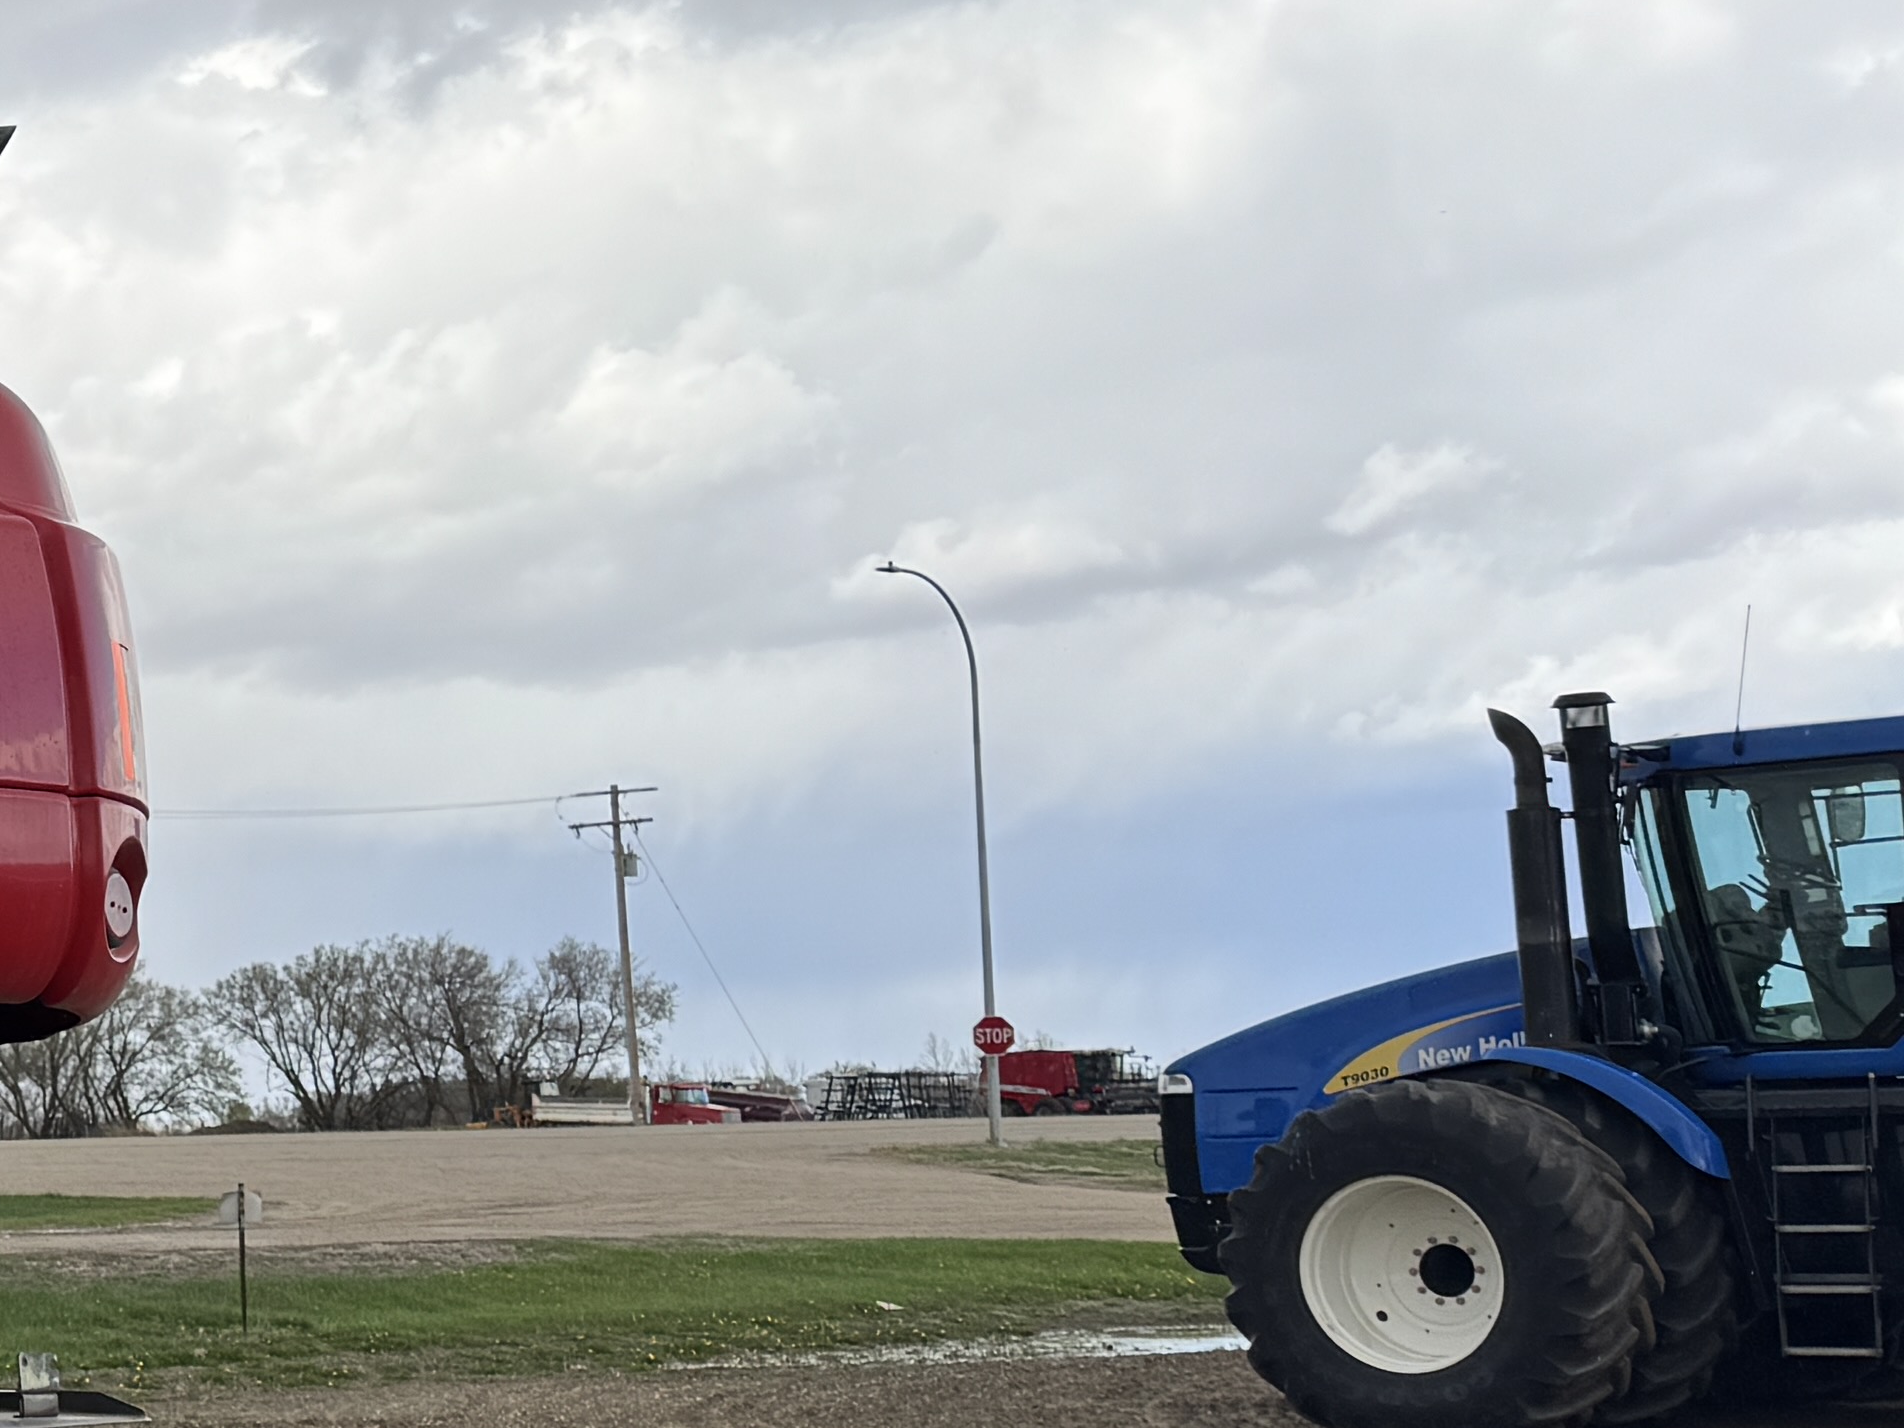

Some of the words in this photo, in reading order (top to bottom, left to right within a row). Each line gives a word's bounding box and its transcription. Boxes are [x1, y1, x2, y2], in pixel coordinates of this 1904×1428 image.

[975, 1027, 1013, 1045] STOP
[1418, 1045, 1471, 1070] New
[1341, 1066, 1390, 1087] T9030
